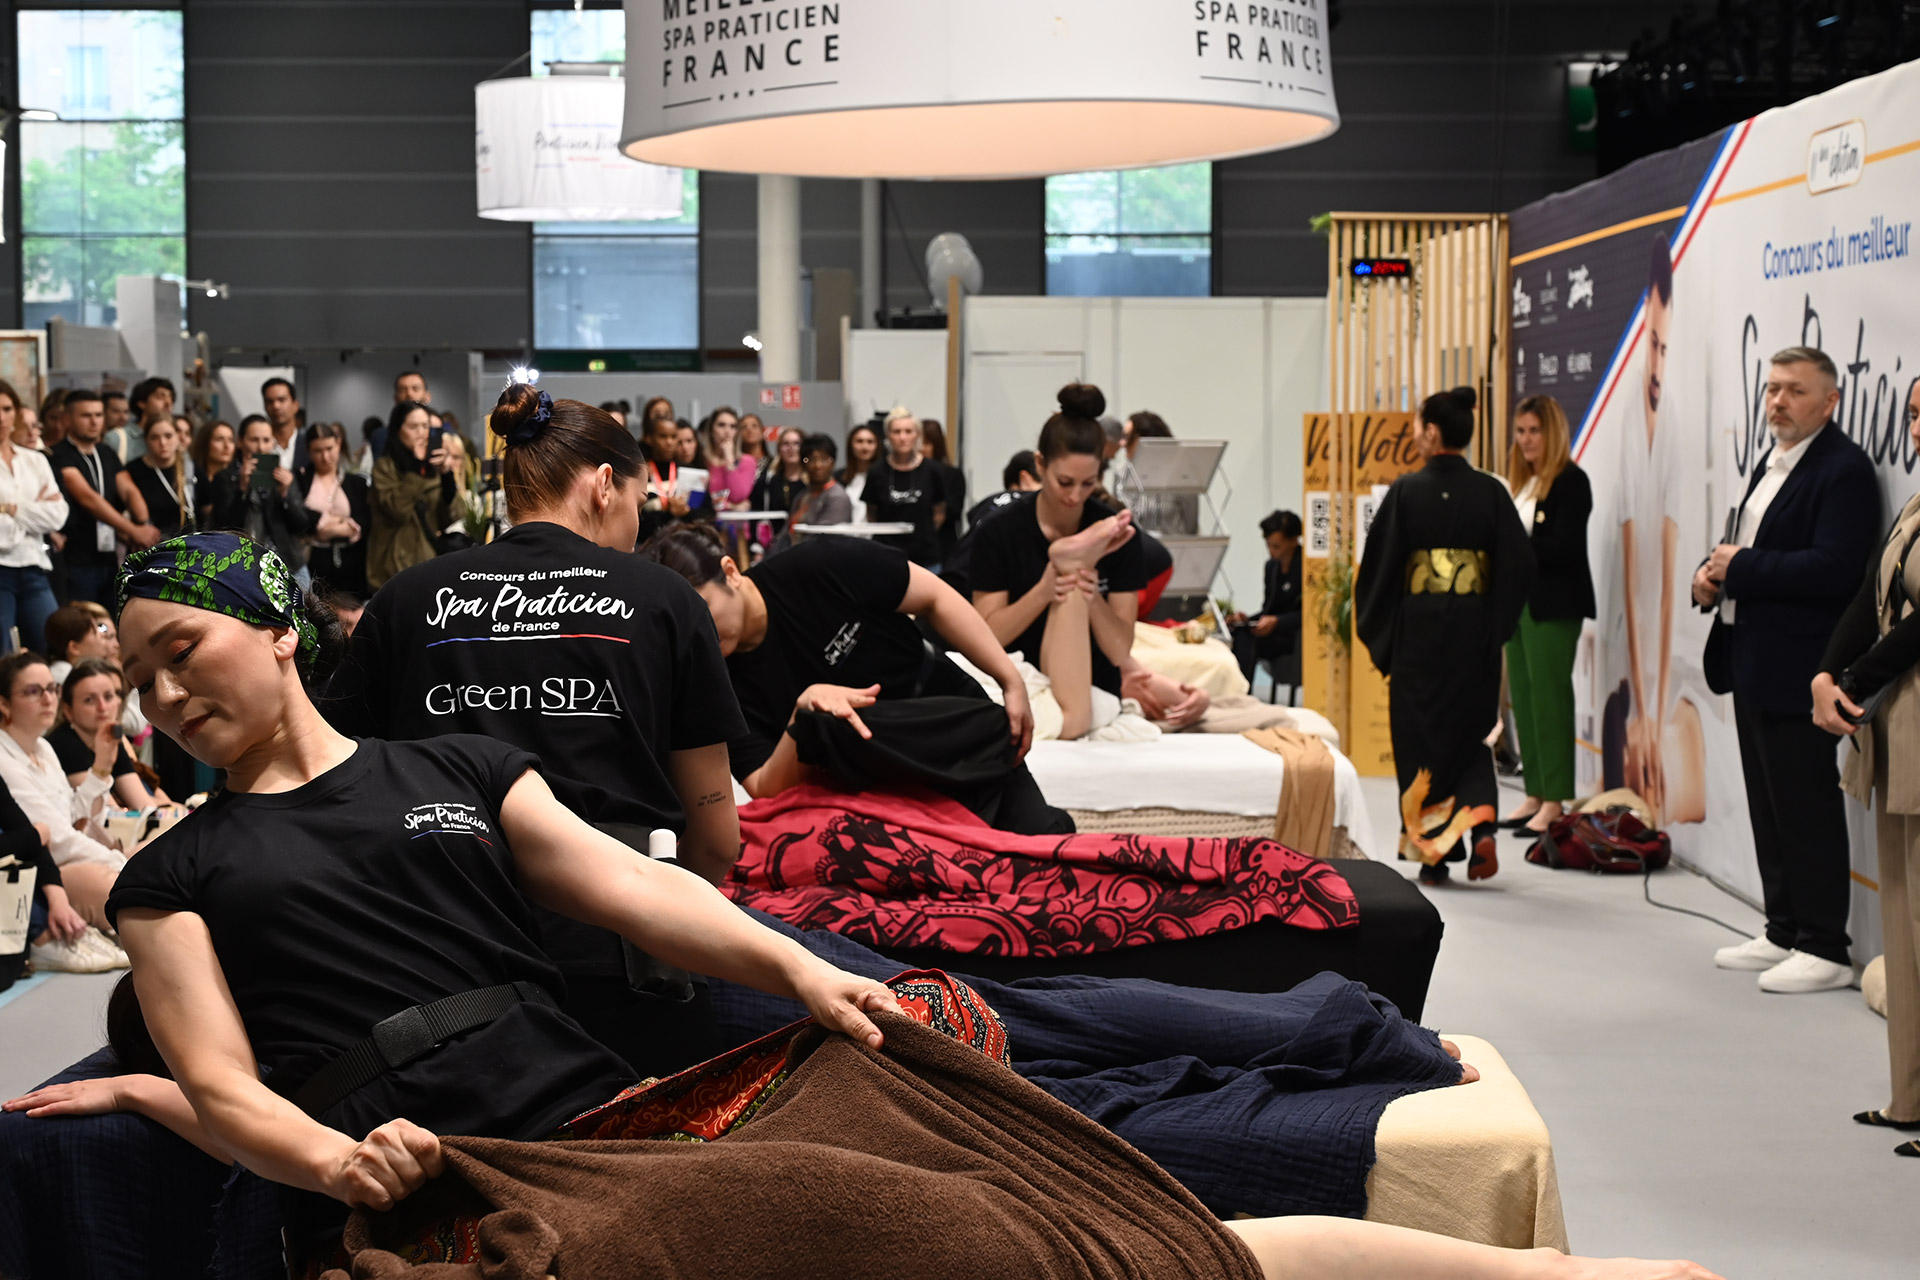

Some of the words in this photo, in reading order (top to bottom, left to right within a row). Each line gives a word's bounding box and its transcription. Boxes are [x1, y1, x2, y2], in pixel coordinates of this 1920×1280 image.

[664, 25, 696, 51] SPA
[704, 3, 840, 43] PRATICIEN
[1195, 0, 1239, 24] SPA
[1248, 4, 1320, 40] PRATICIEN
[662, 34, 839, 88] FRANCE
[1196, 30, 1323, 75] FRANCE
[1763, 241, 1823, 280] Concours
[1826, 225, 1844, 270] du
[1848, 215, 1911, 266] meilleur
[460, 571, 525, 582] Concours
[528, 571, 546, 580] du
[549, 566, 608, 579] meilleur
[426, 587, 489, 629] Spa
[491, 583, 635, 621] Praticien
[491, 622, 511, 633] de
[513, 621, 560, 632] France
[425, 683, 533, 715] Green
[541, 677, 624, 713] SPA
[404, 813, 435, 830] Spa
[435, 806, 489, 833] Praticien
